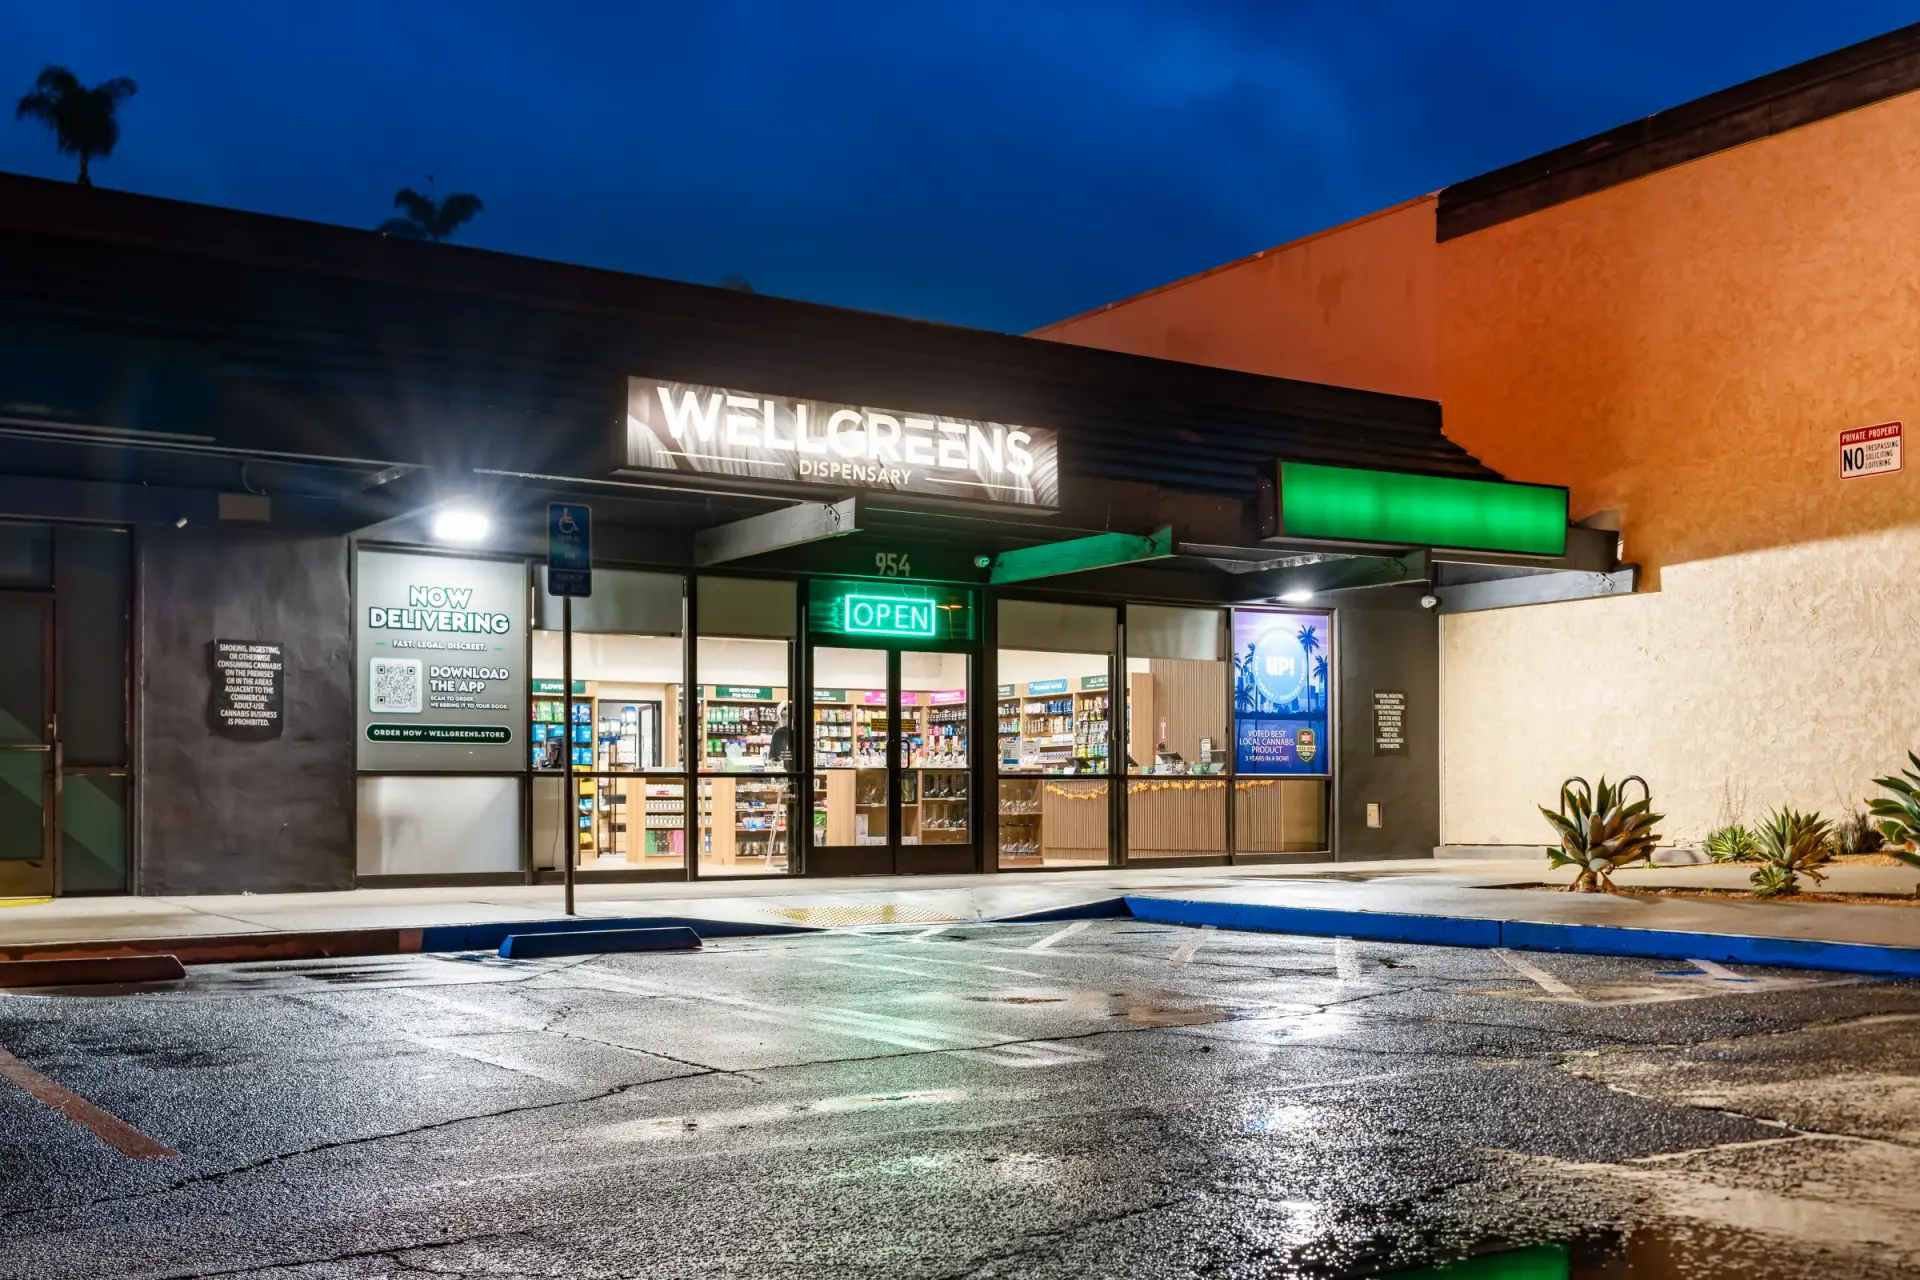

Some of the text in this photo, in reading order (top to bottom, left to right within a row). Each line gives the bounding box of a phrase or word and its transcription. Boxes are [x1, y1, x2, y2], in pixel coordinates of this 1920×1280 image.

[656, 386, 1035, 477] WELLGREENS
[1842, 425, 1899, 444] PRIVATE PROPERTY
[1865, 450, 1893, 461] SOLICITING
[1866, 440, 1899, 452] TRESPASSING
[1843, 447, 1864, 472] NO
[1865, 459, 1892, 469] LOITERING
[798, 458, 912, 485] DISPENSARY
[875, 552, 911, 577] 954
[410, 585, 473, 610] NOW
[369, 606, 510, 634] DELIVERING
[854, 602, 928, 630] OPEN
[392, 640, 487, 651] FAST. LEGAL. DISCREET.
[218, 660, 252, 668] CONSUMING
[430, 665, 509, 680] DOWNLOAD
[1266, 656, 1295, 677] UP!
[430, 680, 486, 693] THE APP
[428, 730, 505, 738] WELLGREENS.STORE
